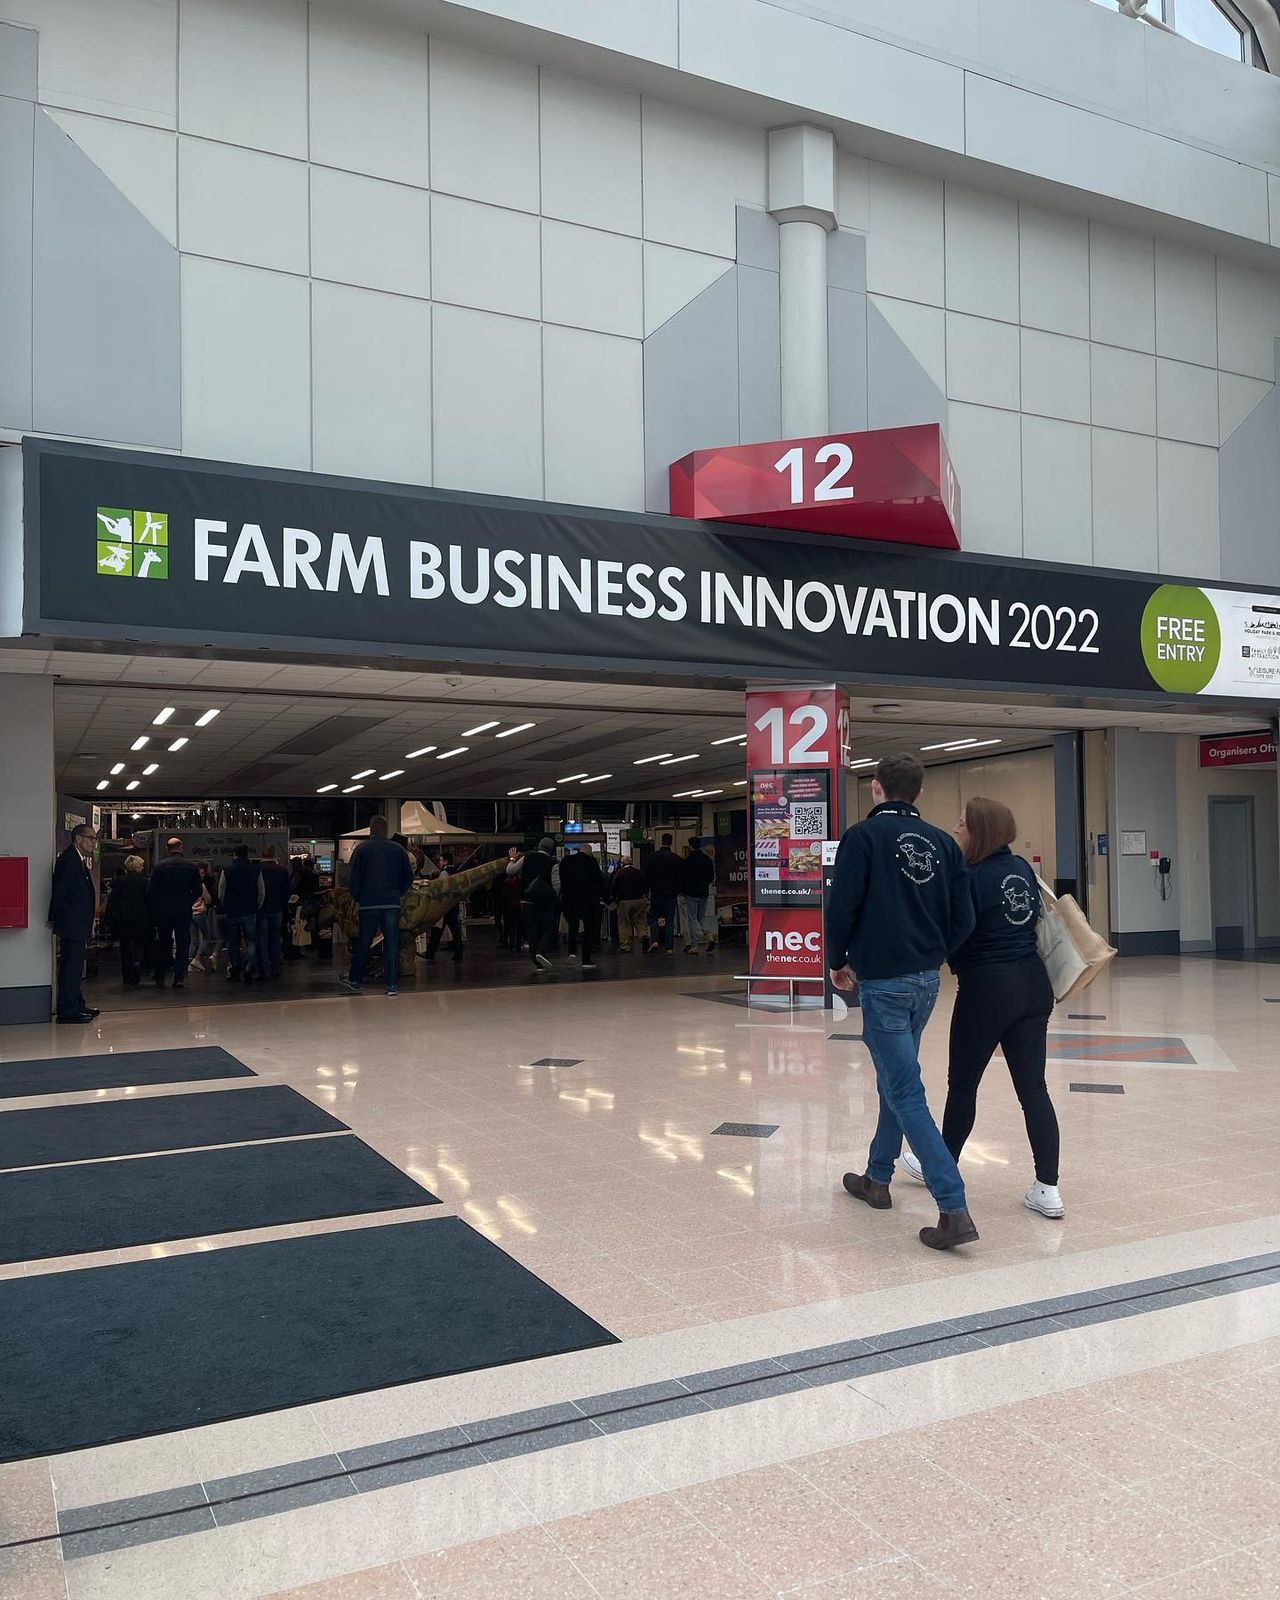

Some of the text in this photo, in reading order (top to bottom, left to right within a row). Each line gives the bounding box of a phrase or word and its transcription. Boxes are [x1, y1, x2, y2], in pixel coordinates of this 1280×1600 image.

[774, 442, 854, 504] 12
[194, 518, 1100, 654] FARM BUSINESS INNOVATION 2022
[1157, 615, 1206, 643] FREE
[1157, 642, 1206, 664] ENTRY
[754, 704, 829, 765] 12
[1209, 746, 1257, 759] Organisers
[826, 878, 834, 887] R
[765, 931, 821, 951] nec
[766, 953, 822, 964] thenec.co.uk
